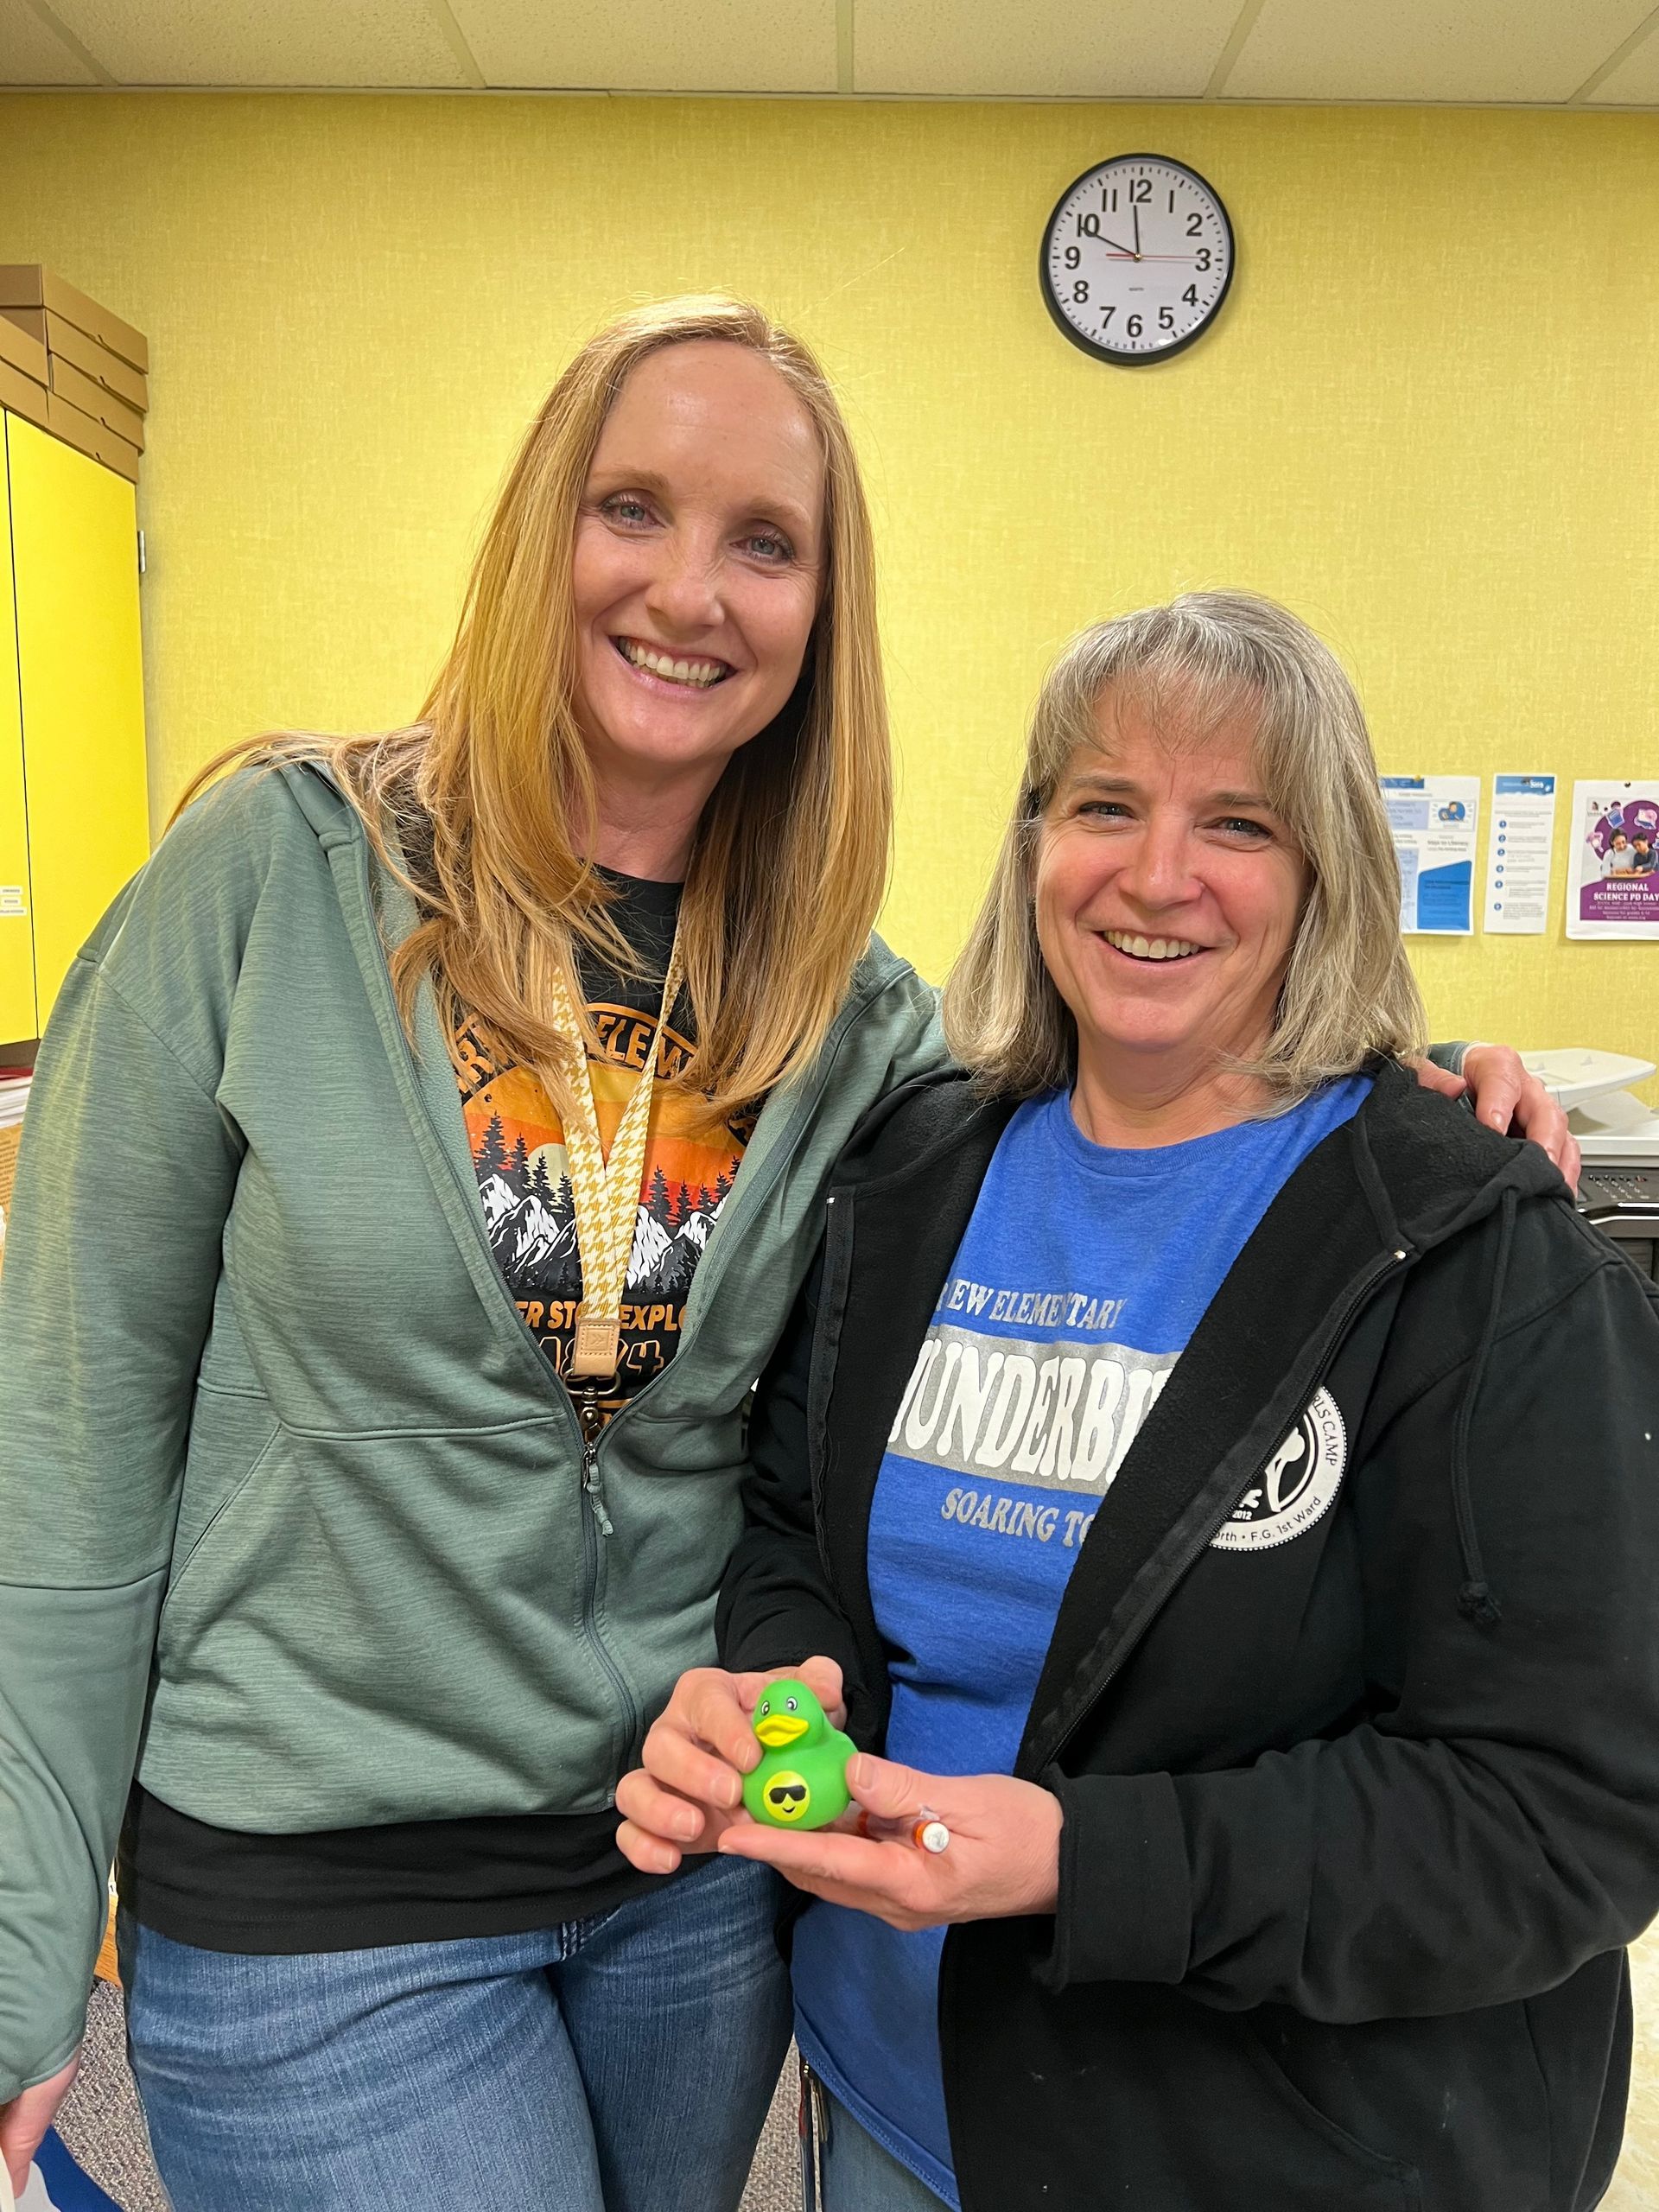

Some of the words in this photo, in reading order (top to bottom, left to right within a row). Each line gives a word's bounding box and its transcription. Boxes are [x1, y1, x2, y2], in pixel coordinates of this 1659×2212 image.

[1102, 188, 1117, 213] 11
[1129, 179, 1153, 203] 12
[1168, 189, 1174, 213] 1
[1077, 213, 1101, 238] 10
[1185, 213, 1203, 237] 2
[1065, 246, 1080, 270] 9
[1195, 248, 1211, 271] 3
[1072, 280, 1090, 303] 8
[1181, 283, 1199, 307] 4
[1099, 306, 1116, 329] 7
[1127, 314, 1143, 338] 6
[1159, 306, 1174, 330] 5
[1593, 892, 1628, 901] SCIENCE
[1643, 893, 1659, 901] DAY
[1606, 882, 1649, 892] REGIONAL
[596, 1014, 693, 1080] ELEM
[548, 1300, 581, 1330] ST
[888, 1338, 1174, 1484] UNDERBI
[1323, 1421, 1338, 1466] CAMP
[941, 1487, 1060, 1542] SOARING
[1231, 1510, 1252, 1521] 2012
[1250, 1530, 1275, 1541] F.G.
[1278, 1521, 1293, 1535] 1st
[1293, 1496, 1322, 1524] Ward
